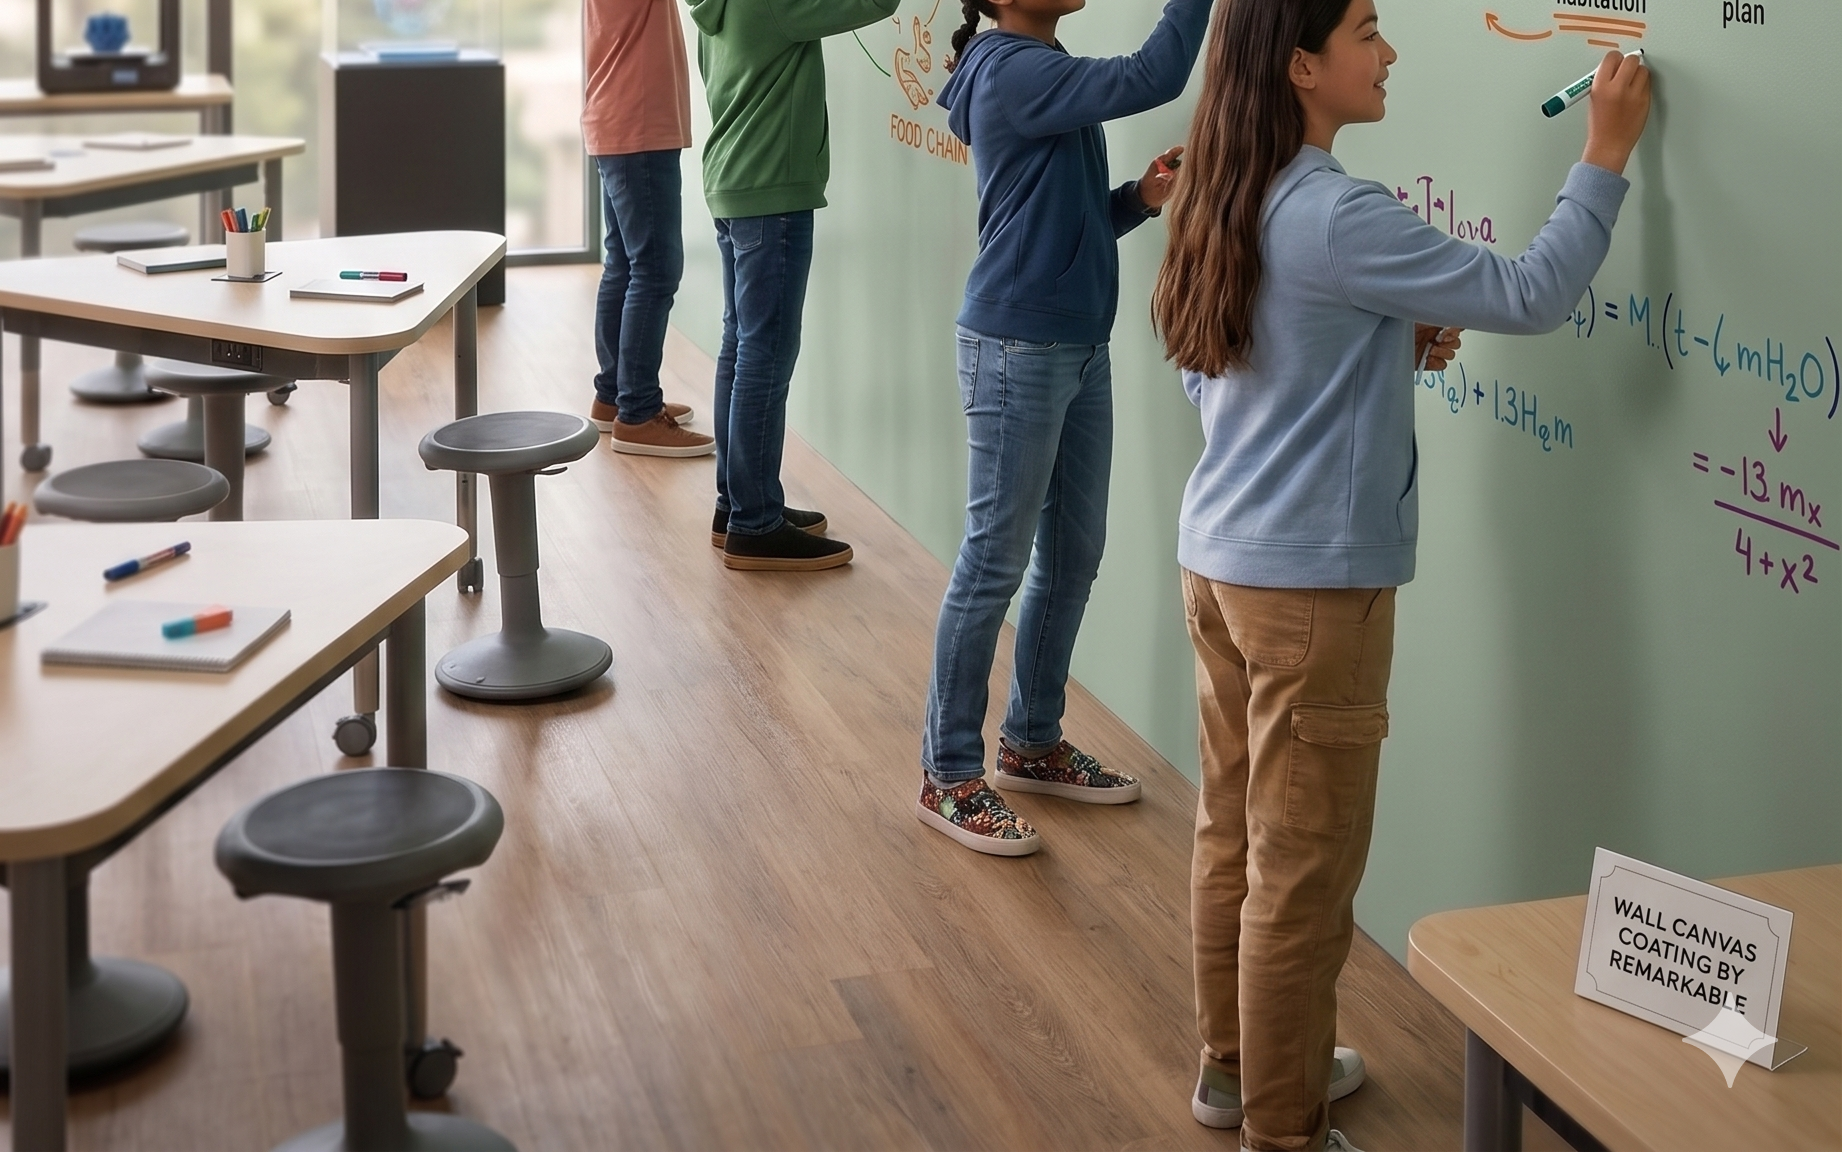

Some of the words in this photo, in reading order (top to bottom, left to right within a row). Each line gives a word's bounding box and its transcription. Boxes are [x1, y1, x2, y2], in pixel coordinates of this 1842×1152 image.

[890, 113, 923, 149] FOOD
[1614, 896, 1666, 932] WALL
[1672, 918, 1757, 963] CANVAS
[1618, 927, 1711, 974] COATING
[1717, 961, 1745, 985] BY
[1609, 949, 1748, 1016] REMARKABLE
